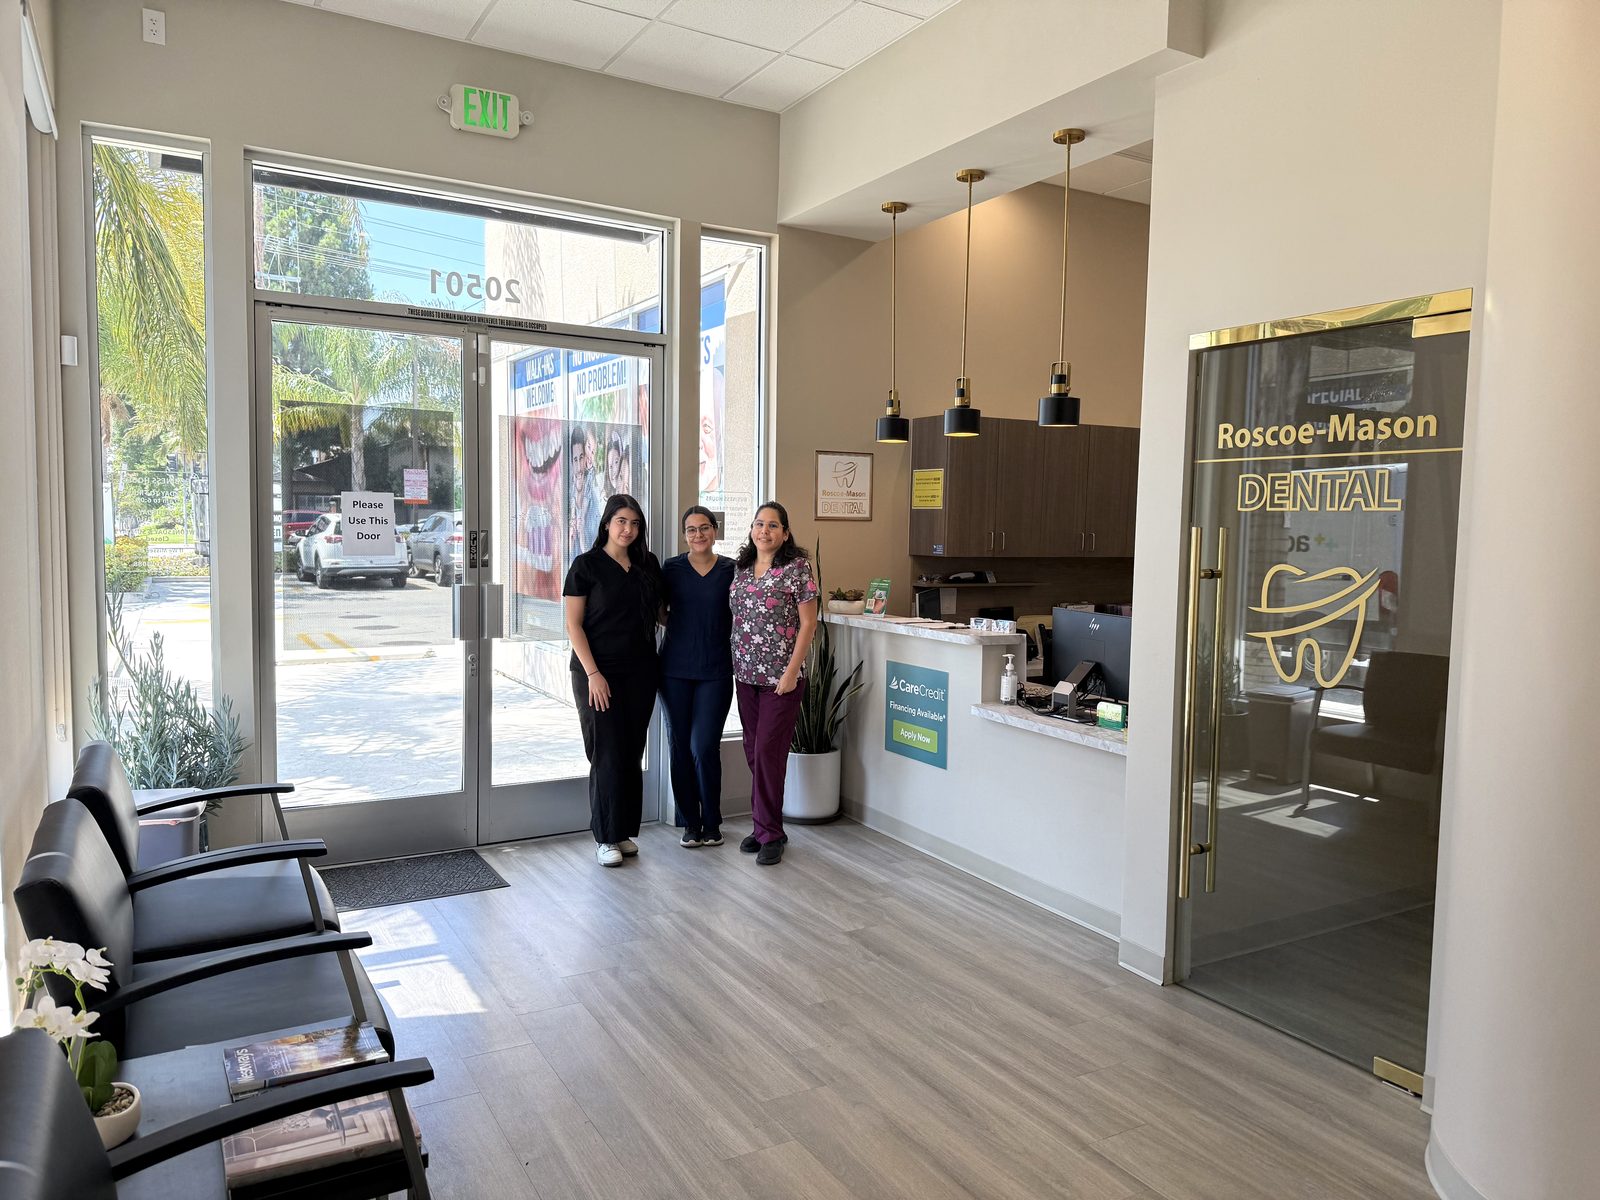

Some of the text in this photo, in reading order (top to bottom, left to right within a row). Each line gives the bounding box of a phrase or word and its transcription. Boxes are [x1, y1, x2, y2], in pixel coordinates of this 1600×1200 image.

[464, 86, 511, 132] EXIT
[407, 308, 420, 316] THESE
[420, 310, 434, 318] DOORS
[441, 312, 456, 320] REMAIN
[457, 313, 476, 323] UNLOCKED
[529, 322, 547, 331] OCCUPIED
[525, 352, 555, 382] WALK-INS
[577, 360, 627, 396] NO PROBLEM!
[526, 382, 554, 409] WELCOME
[1217, 412, 1438, 450] Roscoe-Mason
[822, 489, 866, 498] Roscoe-Mason
[1237, 469, 1403, 512] DENTAL
[352, 500, 384, 509] Please
[822, 501, 866, 514] DENTAL
[348, 516, 389, 525] Use This
[356, 532, 381, 540] Door
[889, 700, 916, 717] Financing
[900, 728, 931, 744] Apply Now
